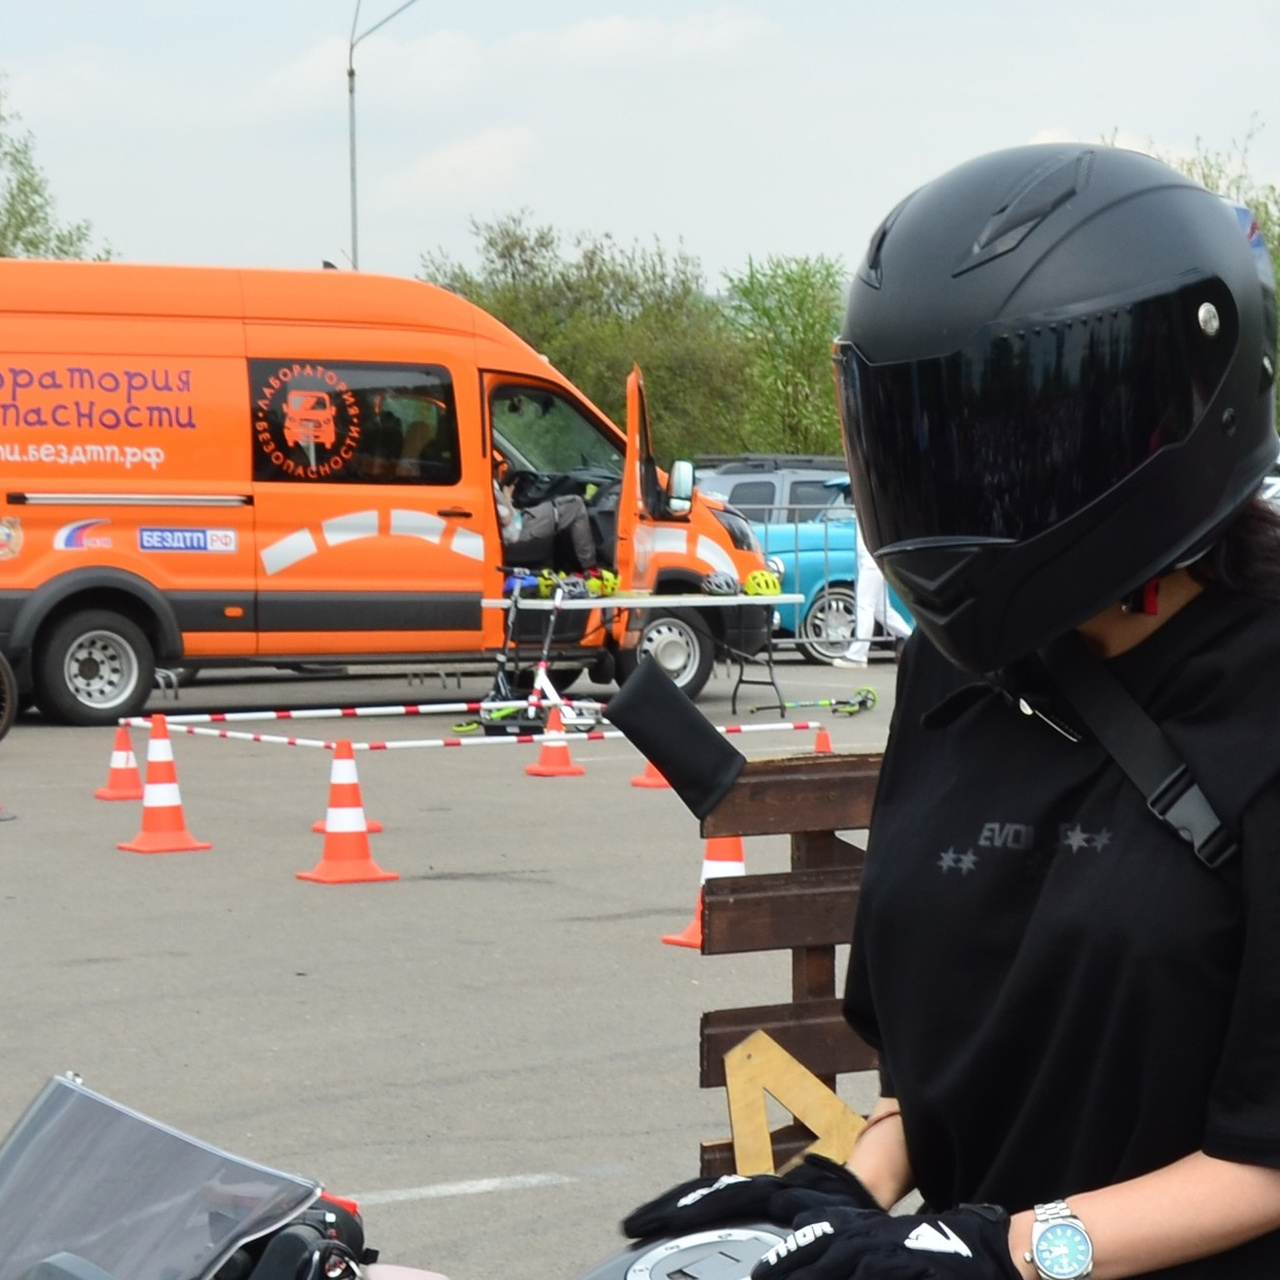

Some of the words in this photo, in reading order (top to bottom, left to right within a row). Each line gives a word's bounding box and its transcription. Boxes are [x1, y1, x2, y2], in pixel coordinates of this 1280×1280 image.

[0, 367, 191, 404] ратория
[257, 364, 360, 418] ЛАБОРАТОРИЯ
[256, 421, 361, 479] БЕЗОПАСНОСТИ
[141, 530, 205, 549] БЕЗДТП
[760, 1221, 835, 1266] THOR
